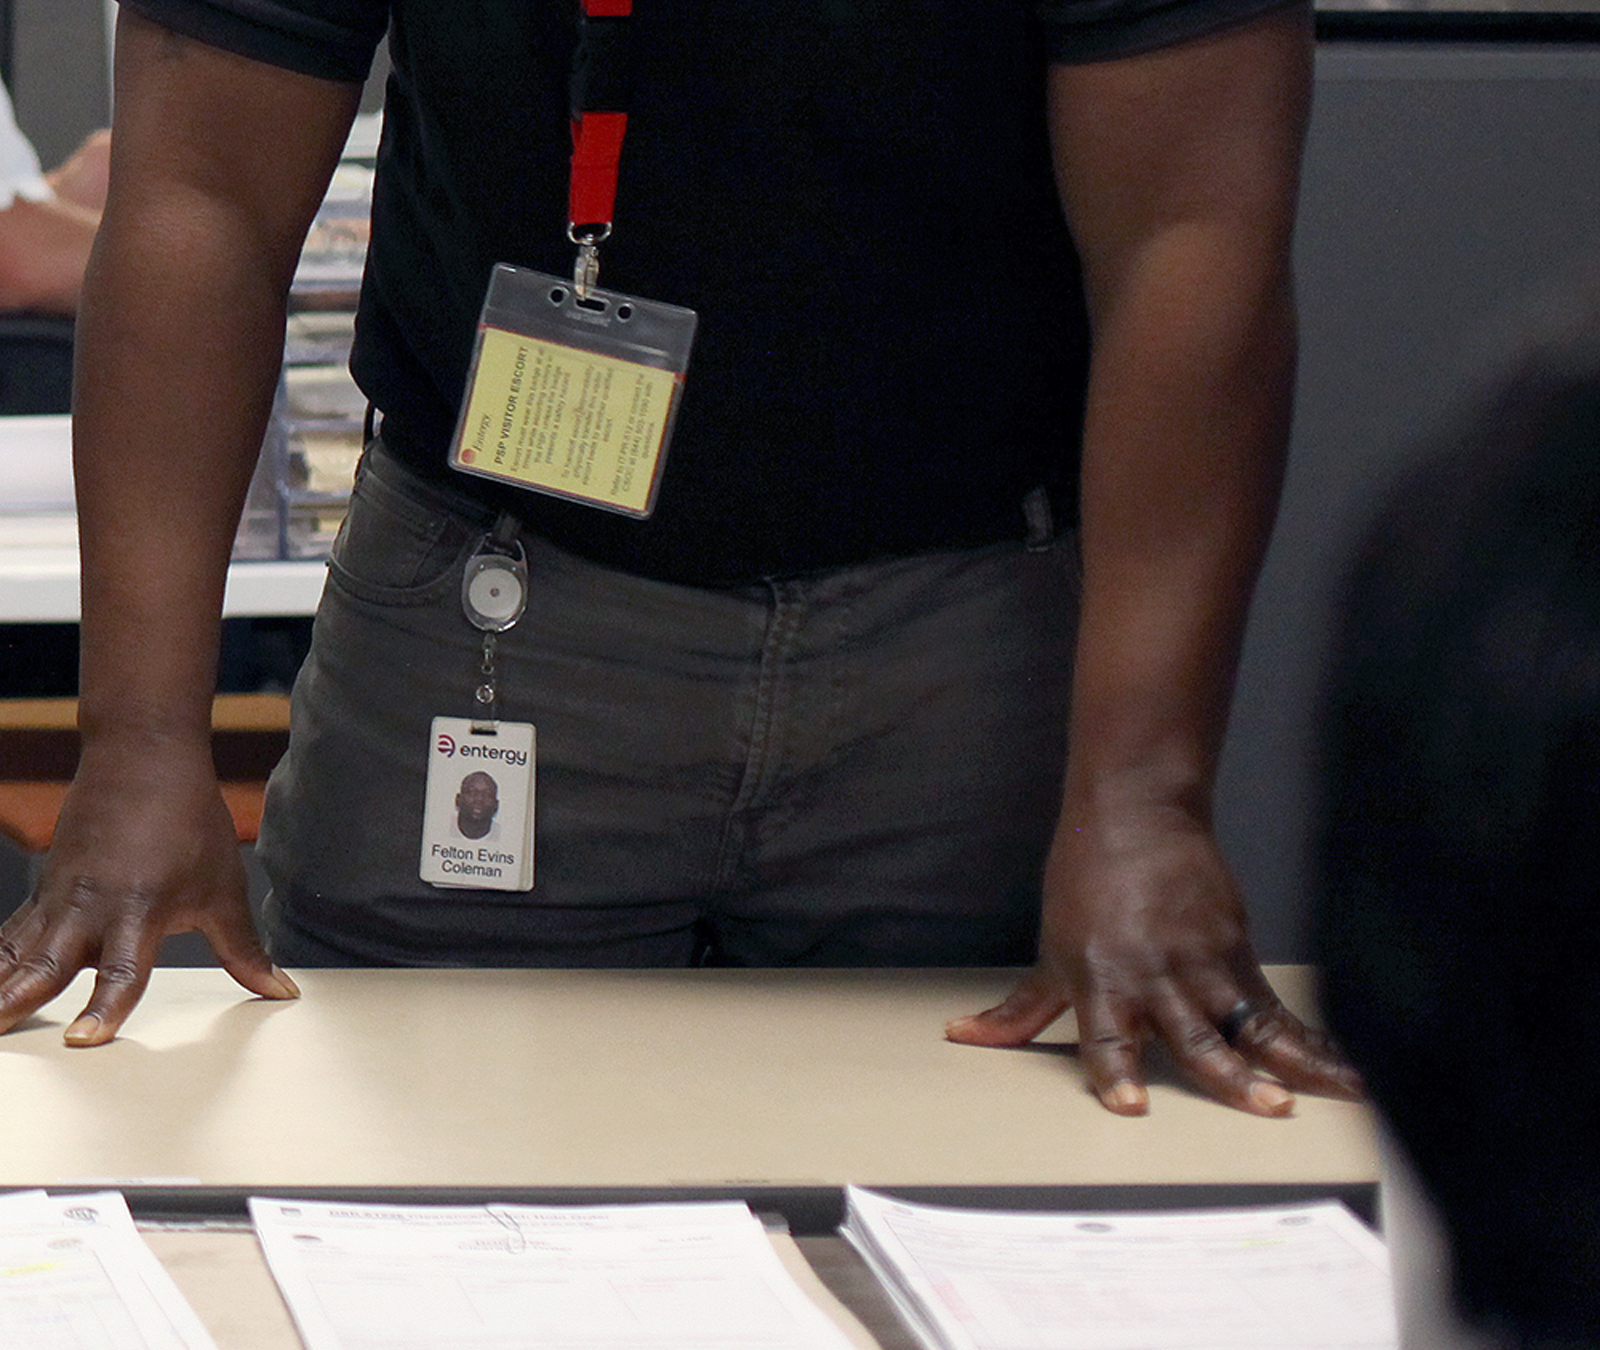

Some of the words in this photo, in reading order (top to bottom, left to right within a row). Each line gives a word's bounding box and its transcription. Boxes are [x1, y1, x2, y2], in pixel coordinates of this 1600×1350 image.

[510, 346, 530, 393] ESCORT
[498, 394, 518, 440] VISITOR
[492, 440, 507, 464] PSP
[460, 744, 527, 765] entergy
[432, 844, 473, 861] Felton
[478, 849, 515, 864] Evins
[442, 860, 502, 877] Coleman
